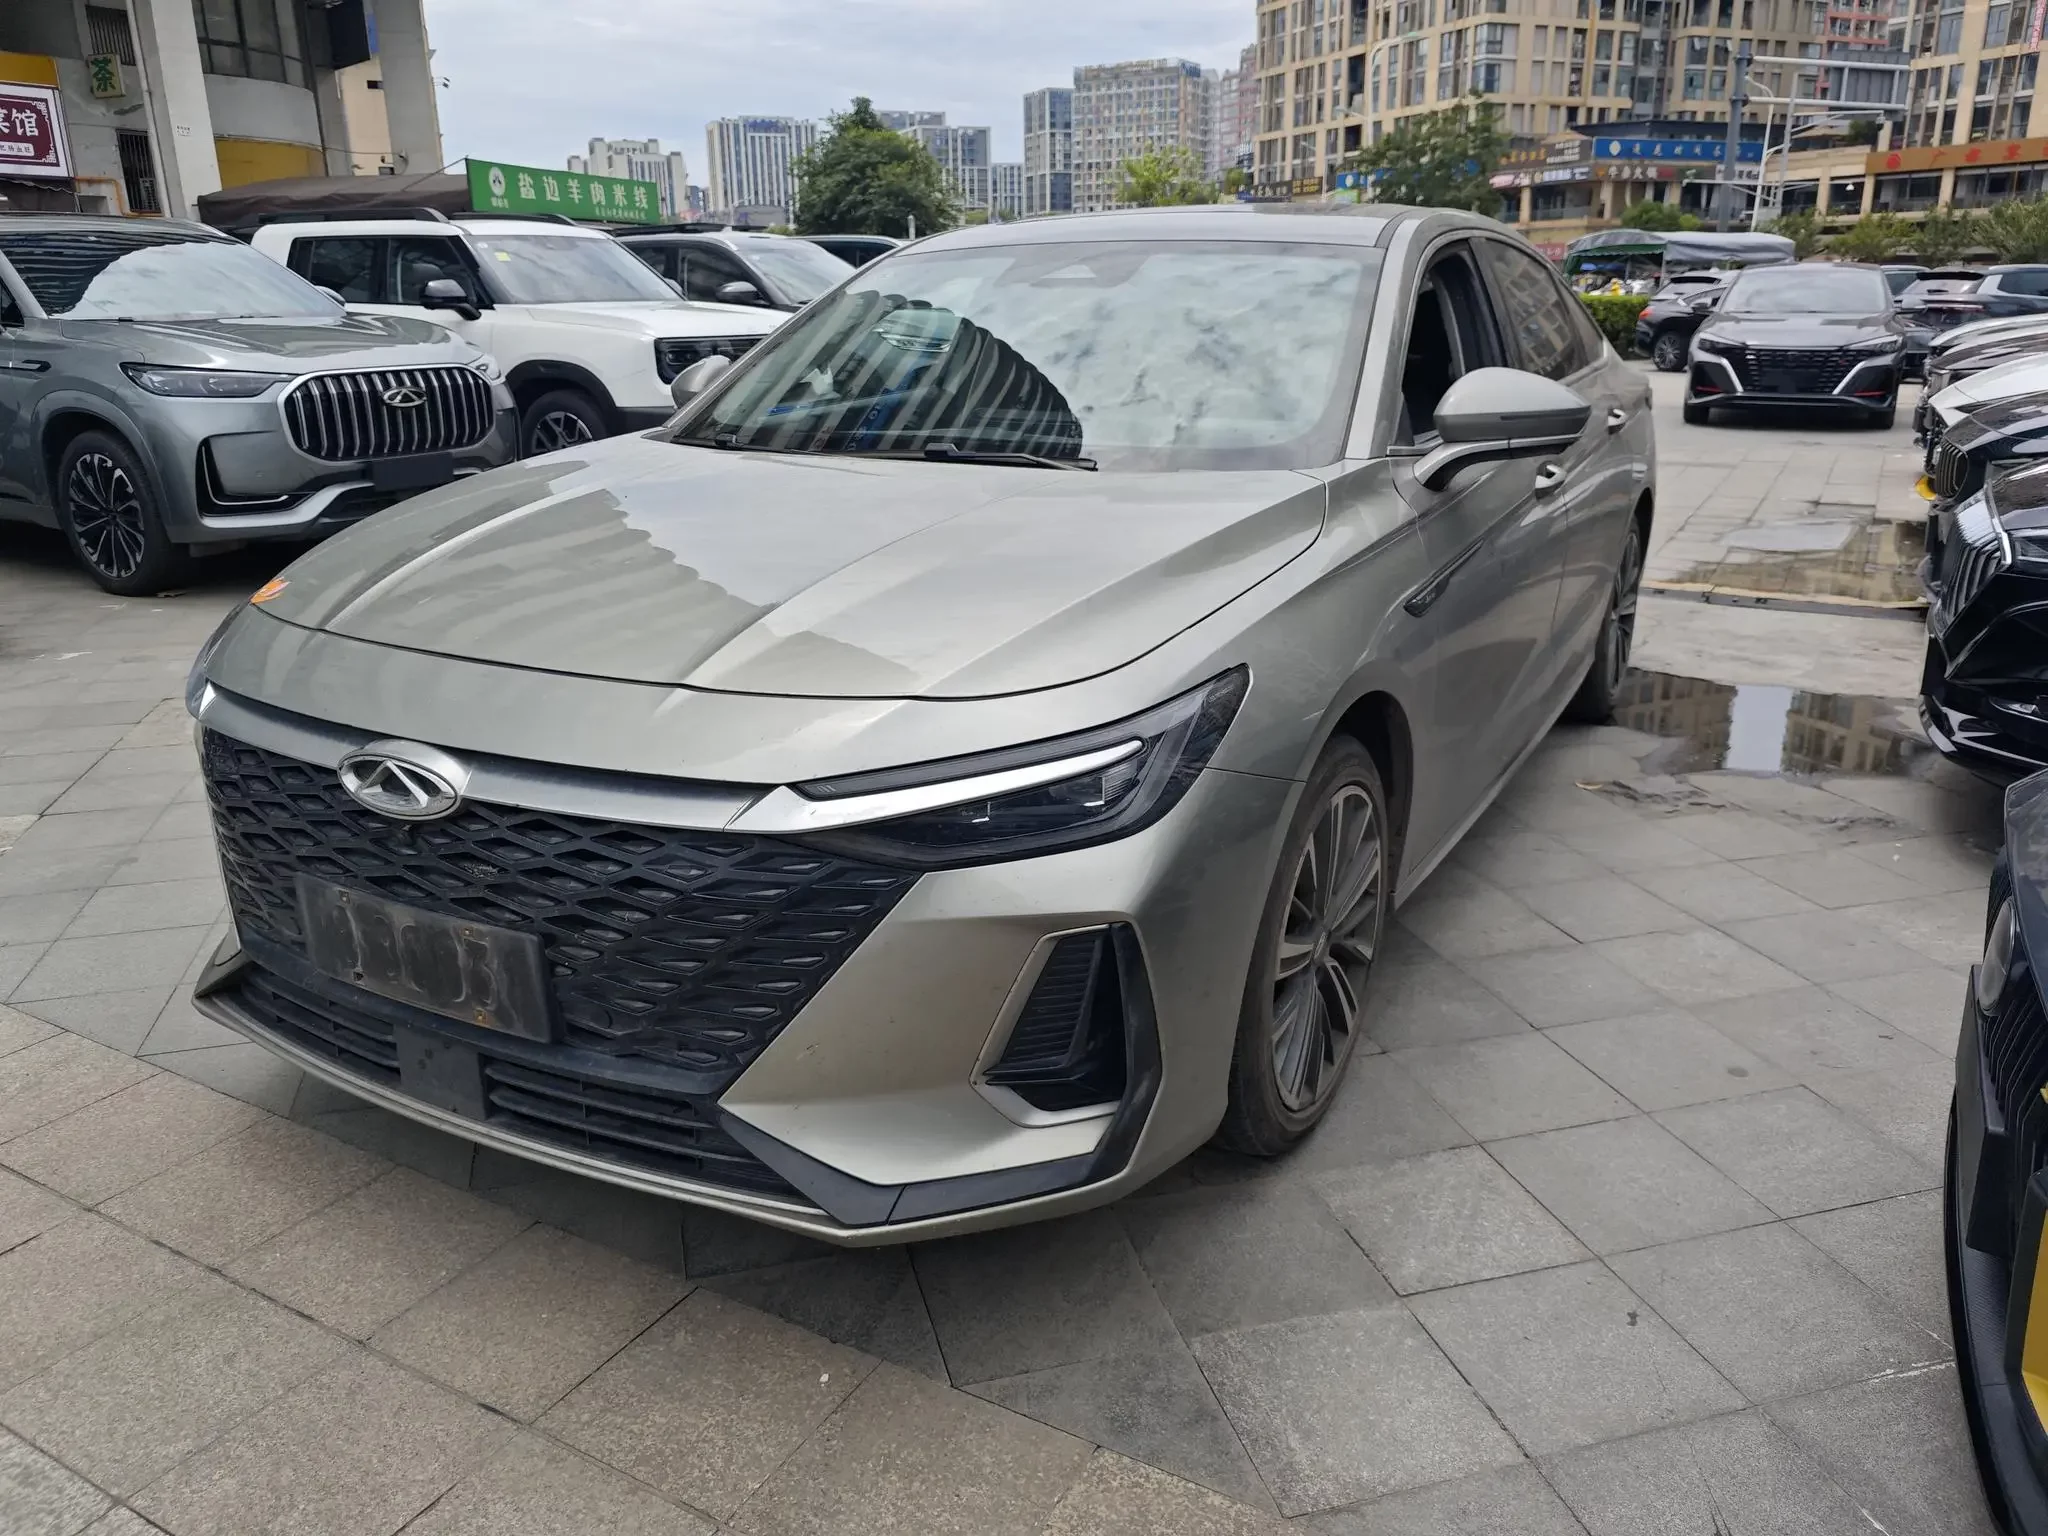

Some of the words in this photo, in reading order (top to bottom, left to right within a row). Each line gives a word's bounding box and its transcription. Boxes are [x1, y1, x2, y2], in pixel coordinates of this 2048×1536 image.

[91, 56, 116, 92] 茶
[518, 172, 648, 209] 盐边羊肉米线
